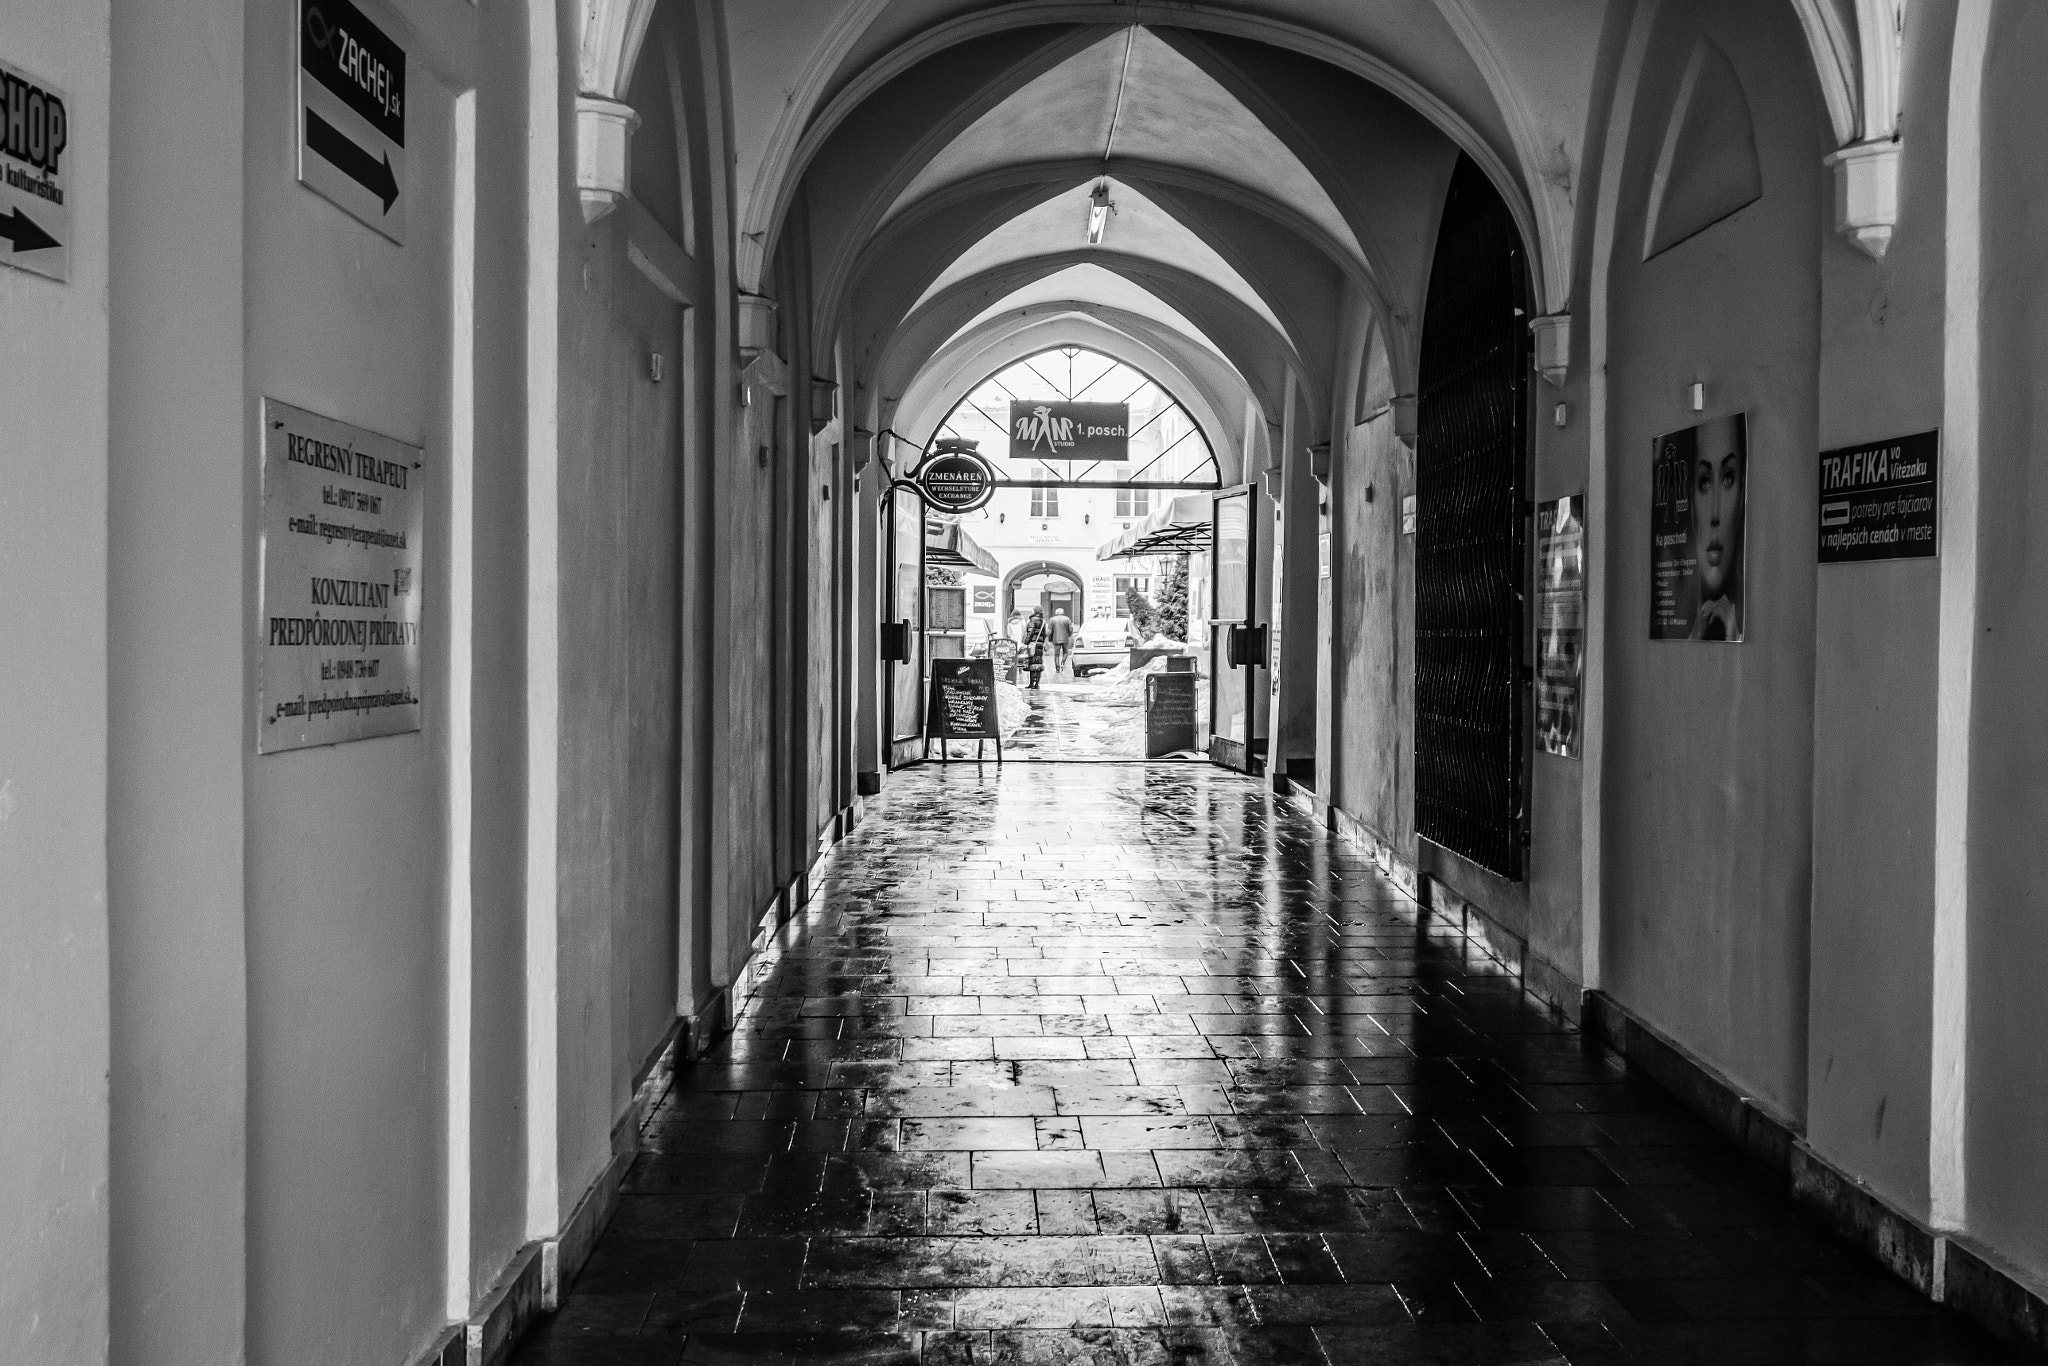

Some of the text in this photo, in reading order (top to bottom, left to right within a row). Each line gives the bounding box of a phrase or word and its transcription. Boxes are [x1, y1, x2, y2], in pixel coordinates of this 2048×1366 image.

[1077, 423, 1128, 438] 1. posch.
[1054, 441, 1075, 451] STUDIO
[288, 433, 408, 489] REGRESNÝ TERAPEUT
[1823, 446, 1901, 490] TRAFIKA vo
[1851, 495, 1933, 523] potreby pre fajčiarov
[289, 514, 318, 535] e-mail:
[1821, 523, 1932, 551] v najlepších cenách v meste
[312, 577, 390, 608] KONZULTANT
[270, 611, 417, 652] PREDPÔRODNEJ PRÍPRAVY
[276, 695, 306, 717] e-mail:
